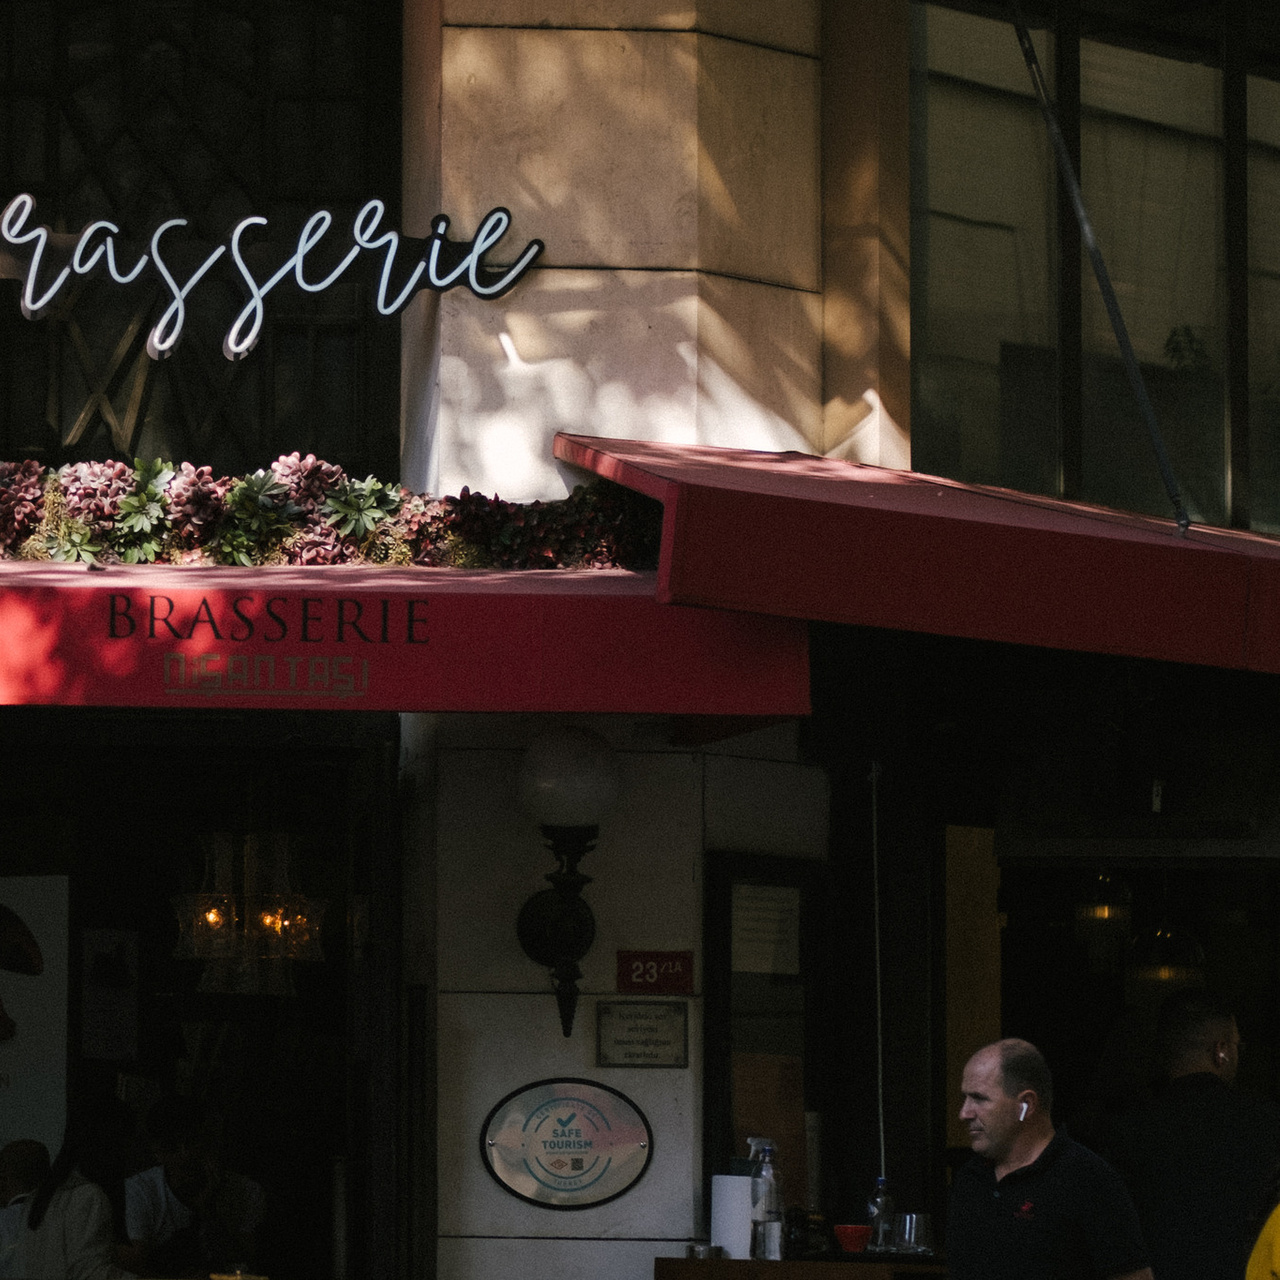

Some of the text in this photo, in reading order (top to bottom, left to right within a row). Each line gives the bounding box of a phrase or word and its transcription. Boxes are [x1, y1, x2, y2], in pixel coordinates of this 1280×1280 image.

[108, 593, 430, 645] BRASSERIE
[552, 1129, 582, 1138] SAFE
[541, 1140, 593, 1150] TOURISM
